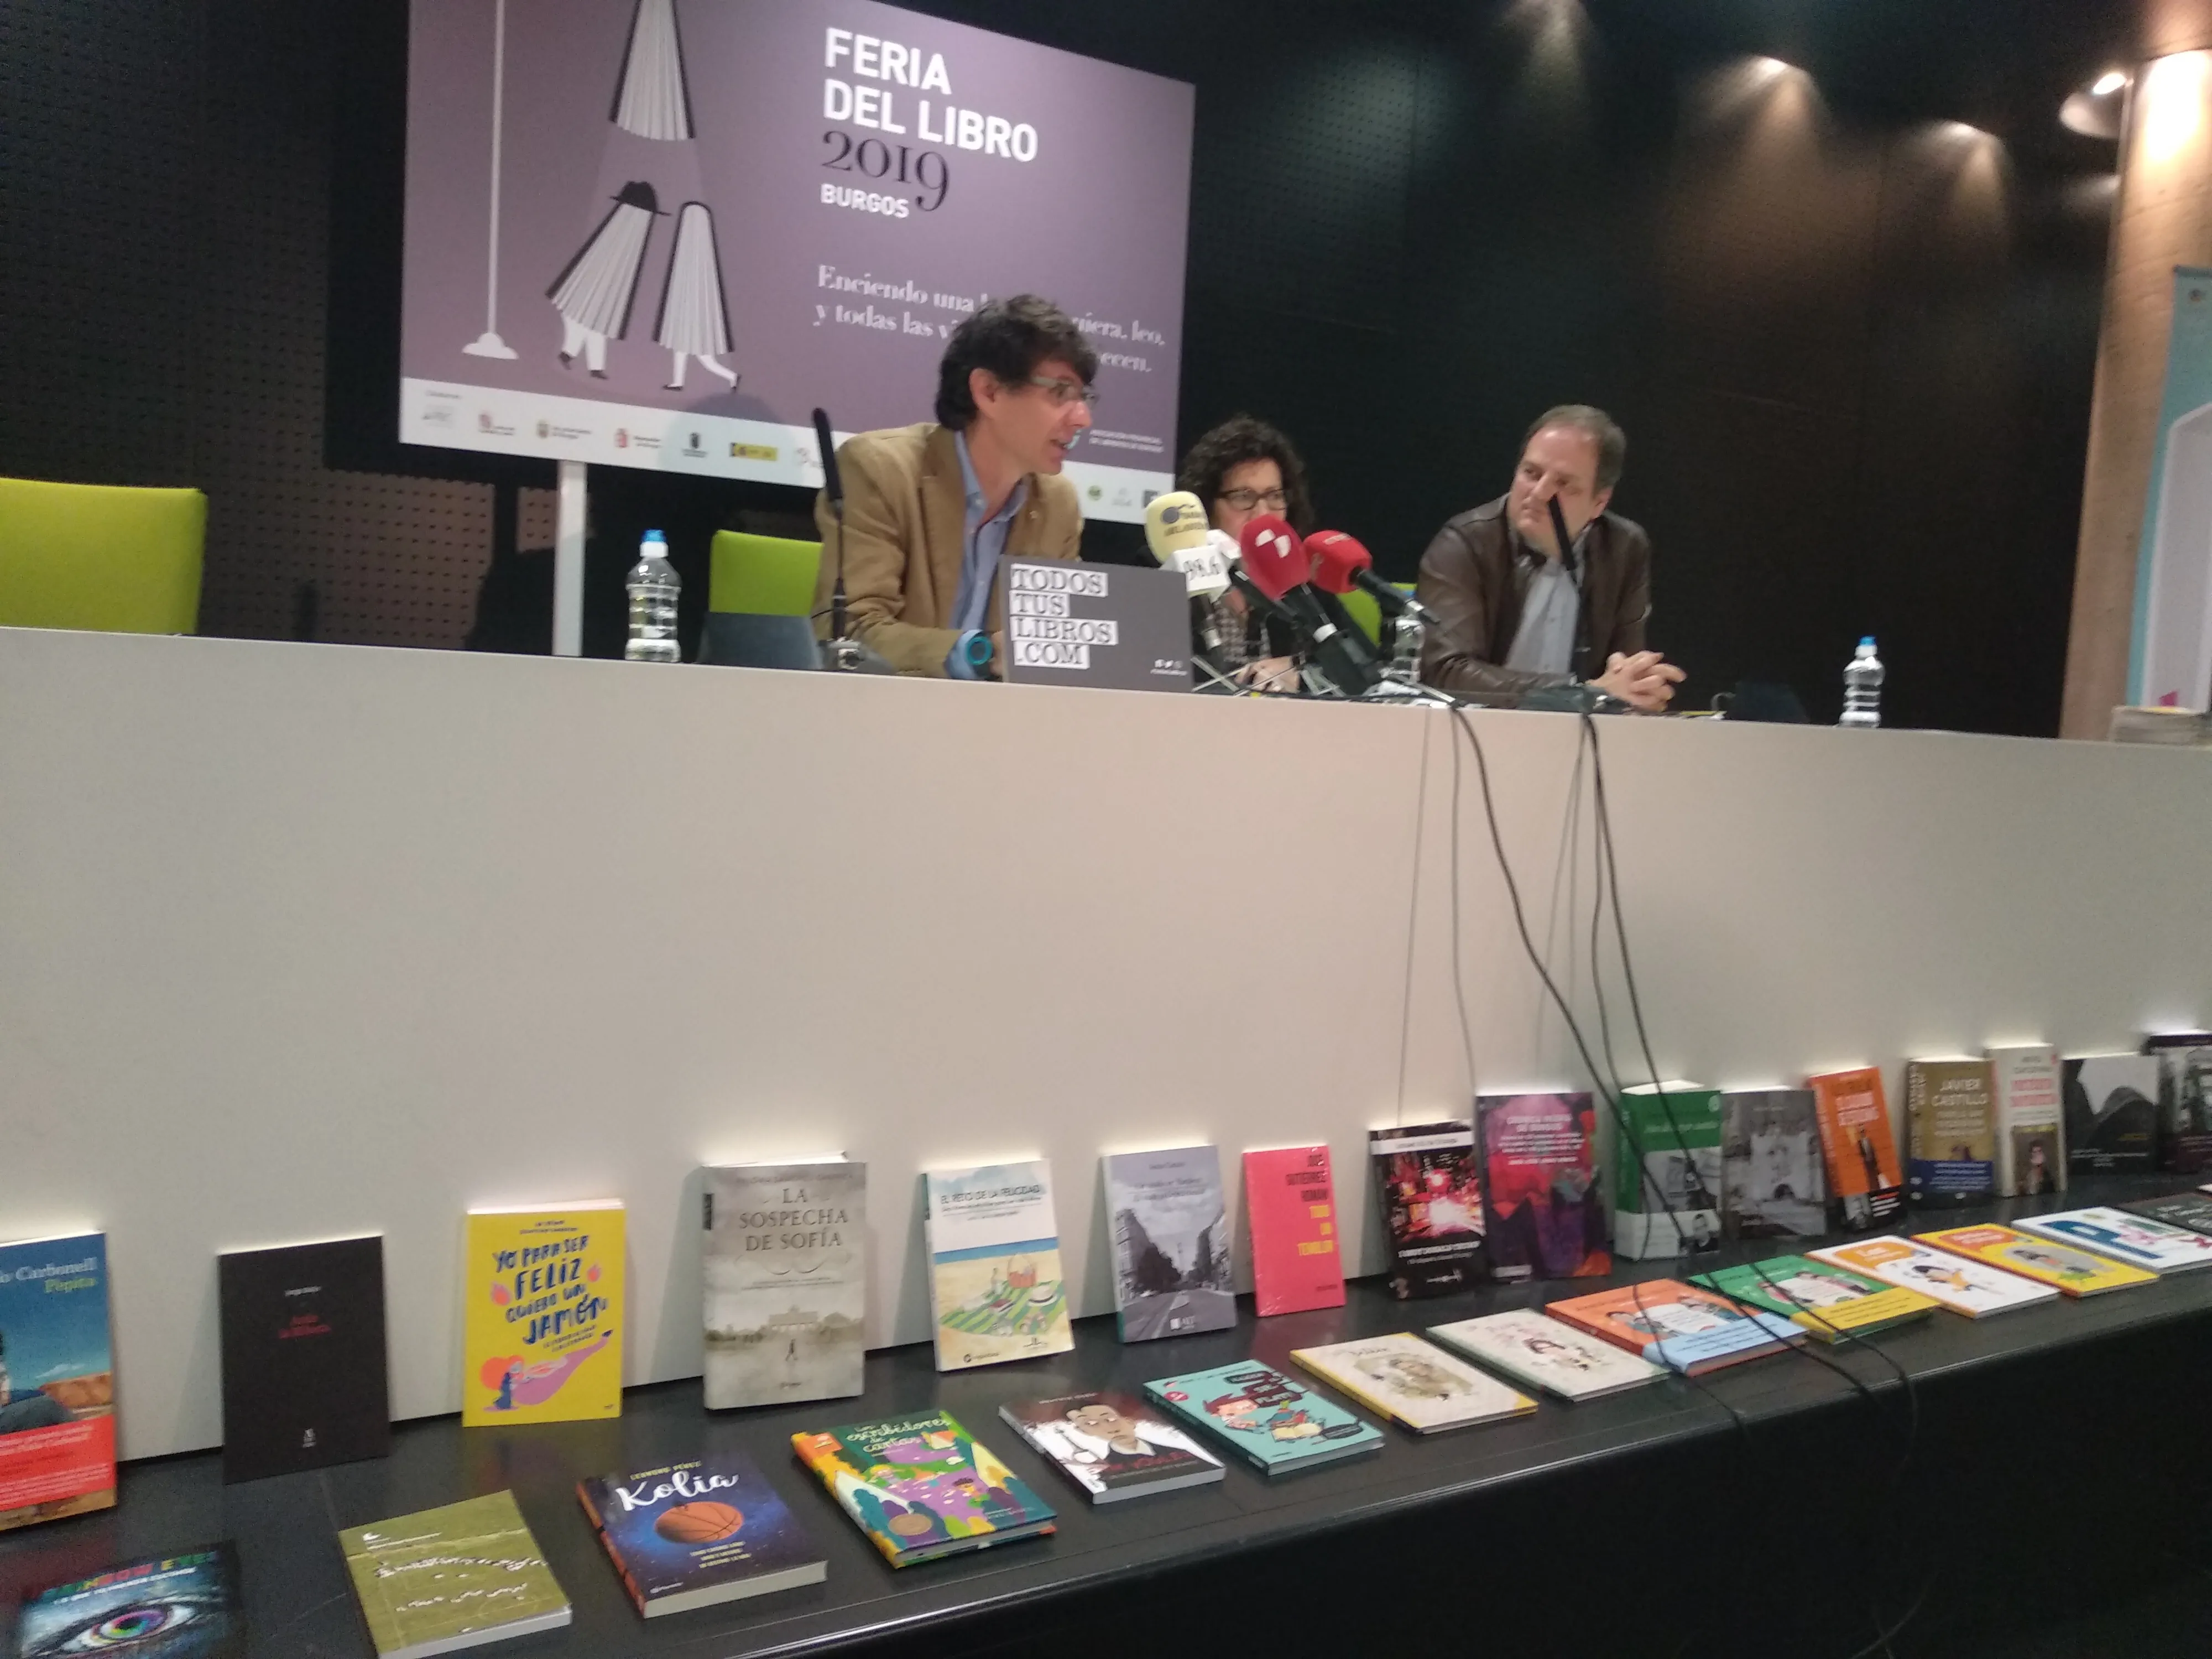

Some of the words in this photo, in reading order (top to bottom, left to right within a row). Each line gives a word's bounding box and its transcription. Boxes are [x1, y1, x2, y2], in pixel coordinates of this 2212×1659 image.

[825, 27, 952, 95] FERIA
[823, 79, 906, 135] DEL
[918, 101, 1038, 162] LIBRO
[822, 131, 950, 212] 2019
[820, 183, 909, 218] BURGOS
[818, 264, 928, 304] Enciendo
[933, 293, 974, 312] una
[813, 305, 828, 327] y
[836, 305, 897, 331] todas
[904, 311, 933, 337] las
[1016, 568, 1102, 593] TODOS
[1016, 594, 1063, 615] TUS
[1015, 618, 1111, 644] LIBROS
[1018, 642, 1084, 665] .COM
[782, 1188, 809, 1204] LA
[739, 1208, 849, 1229] SOSPECHA
[521, 1242, 562, 1267] PARA
[563, 1234, 589, 1253] SER
[745, 1234, 773, 1252] DE
[780, 1227, 843, 1250] SOFÍA
[514, 1257, 582, 1300] FELIZ
[847, 1418, 952, 1441] escribidores
[862, 1436, 922, 1453] cartas
[615, 1470, 740, 1512] Kolia
